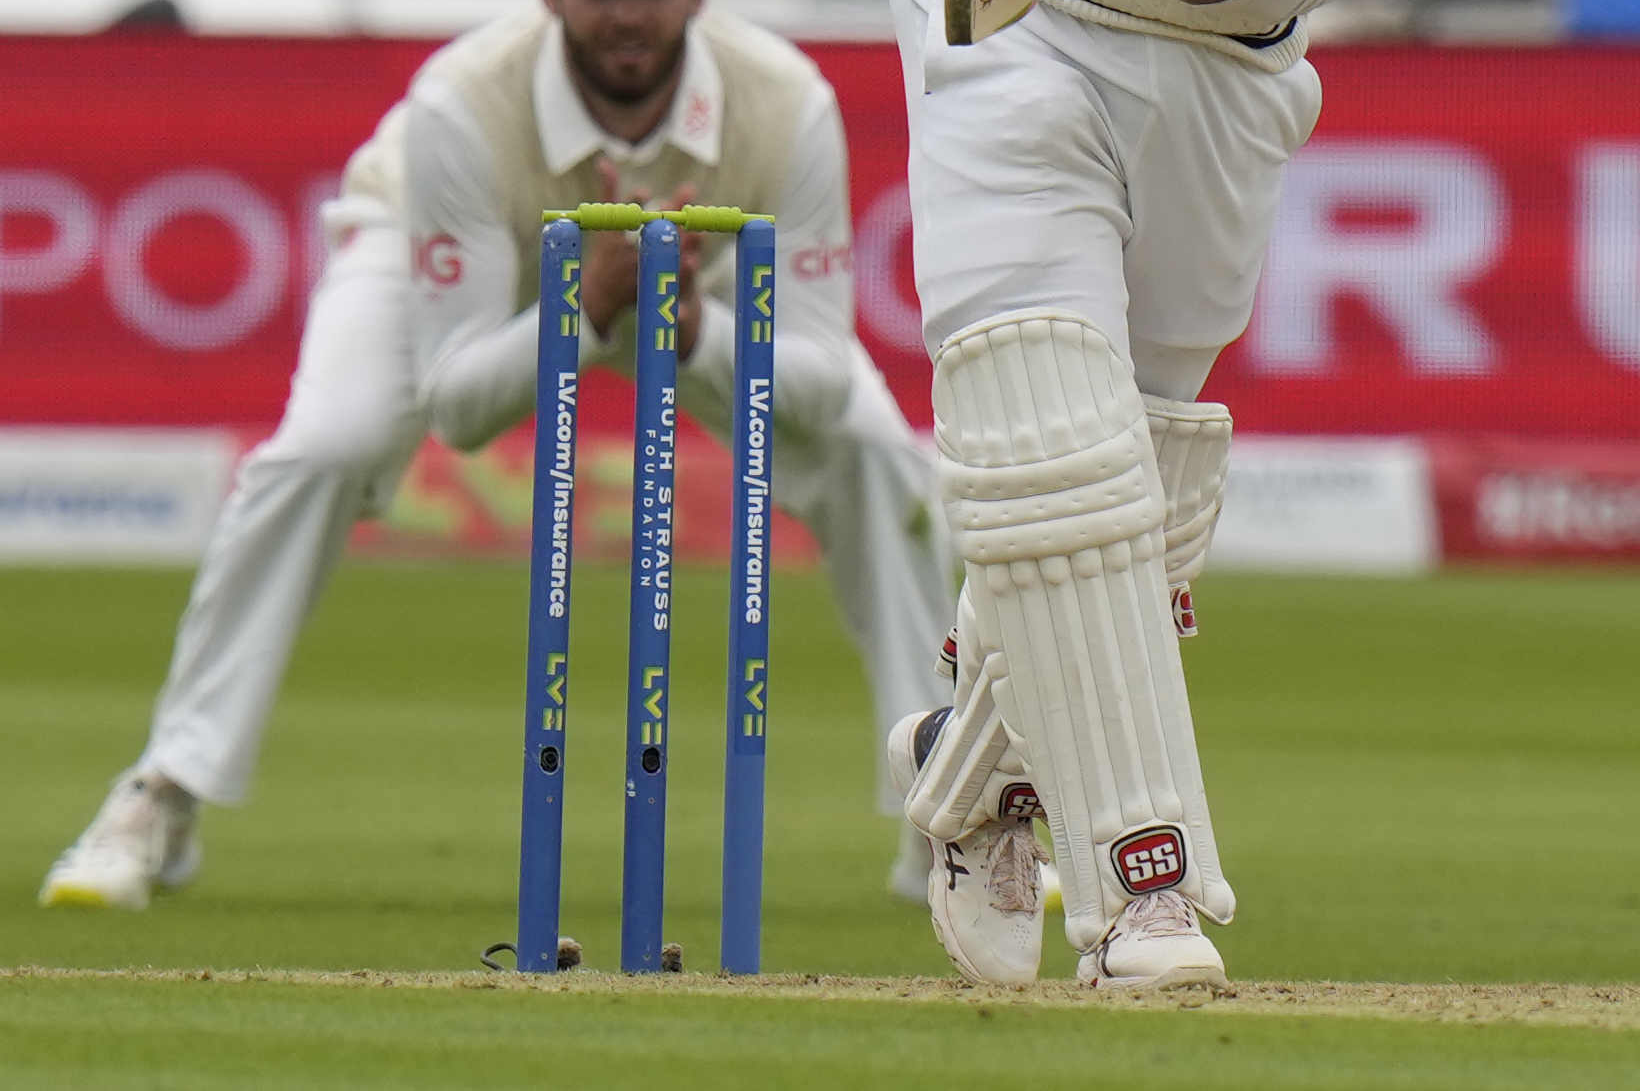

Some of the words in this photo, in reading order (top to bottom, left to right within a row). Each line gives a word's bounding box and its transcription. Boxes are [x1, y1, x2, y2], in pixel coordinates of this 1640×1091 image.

[0, 169, 340, 352] PO
[549, 372, 577, 618] LV.com/insurance
[659, 387, 676, 471] RUTH
[743, 378, 770, 624] LV.com/insurance
[639, 429, 657, 587] FOUNDATION
[654, 486, 673, 631] STRAUSS
[1008, 794, 1044, 816] S
[1124, 842, 1179, 883] SS
